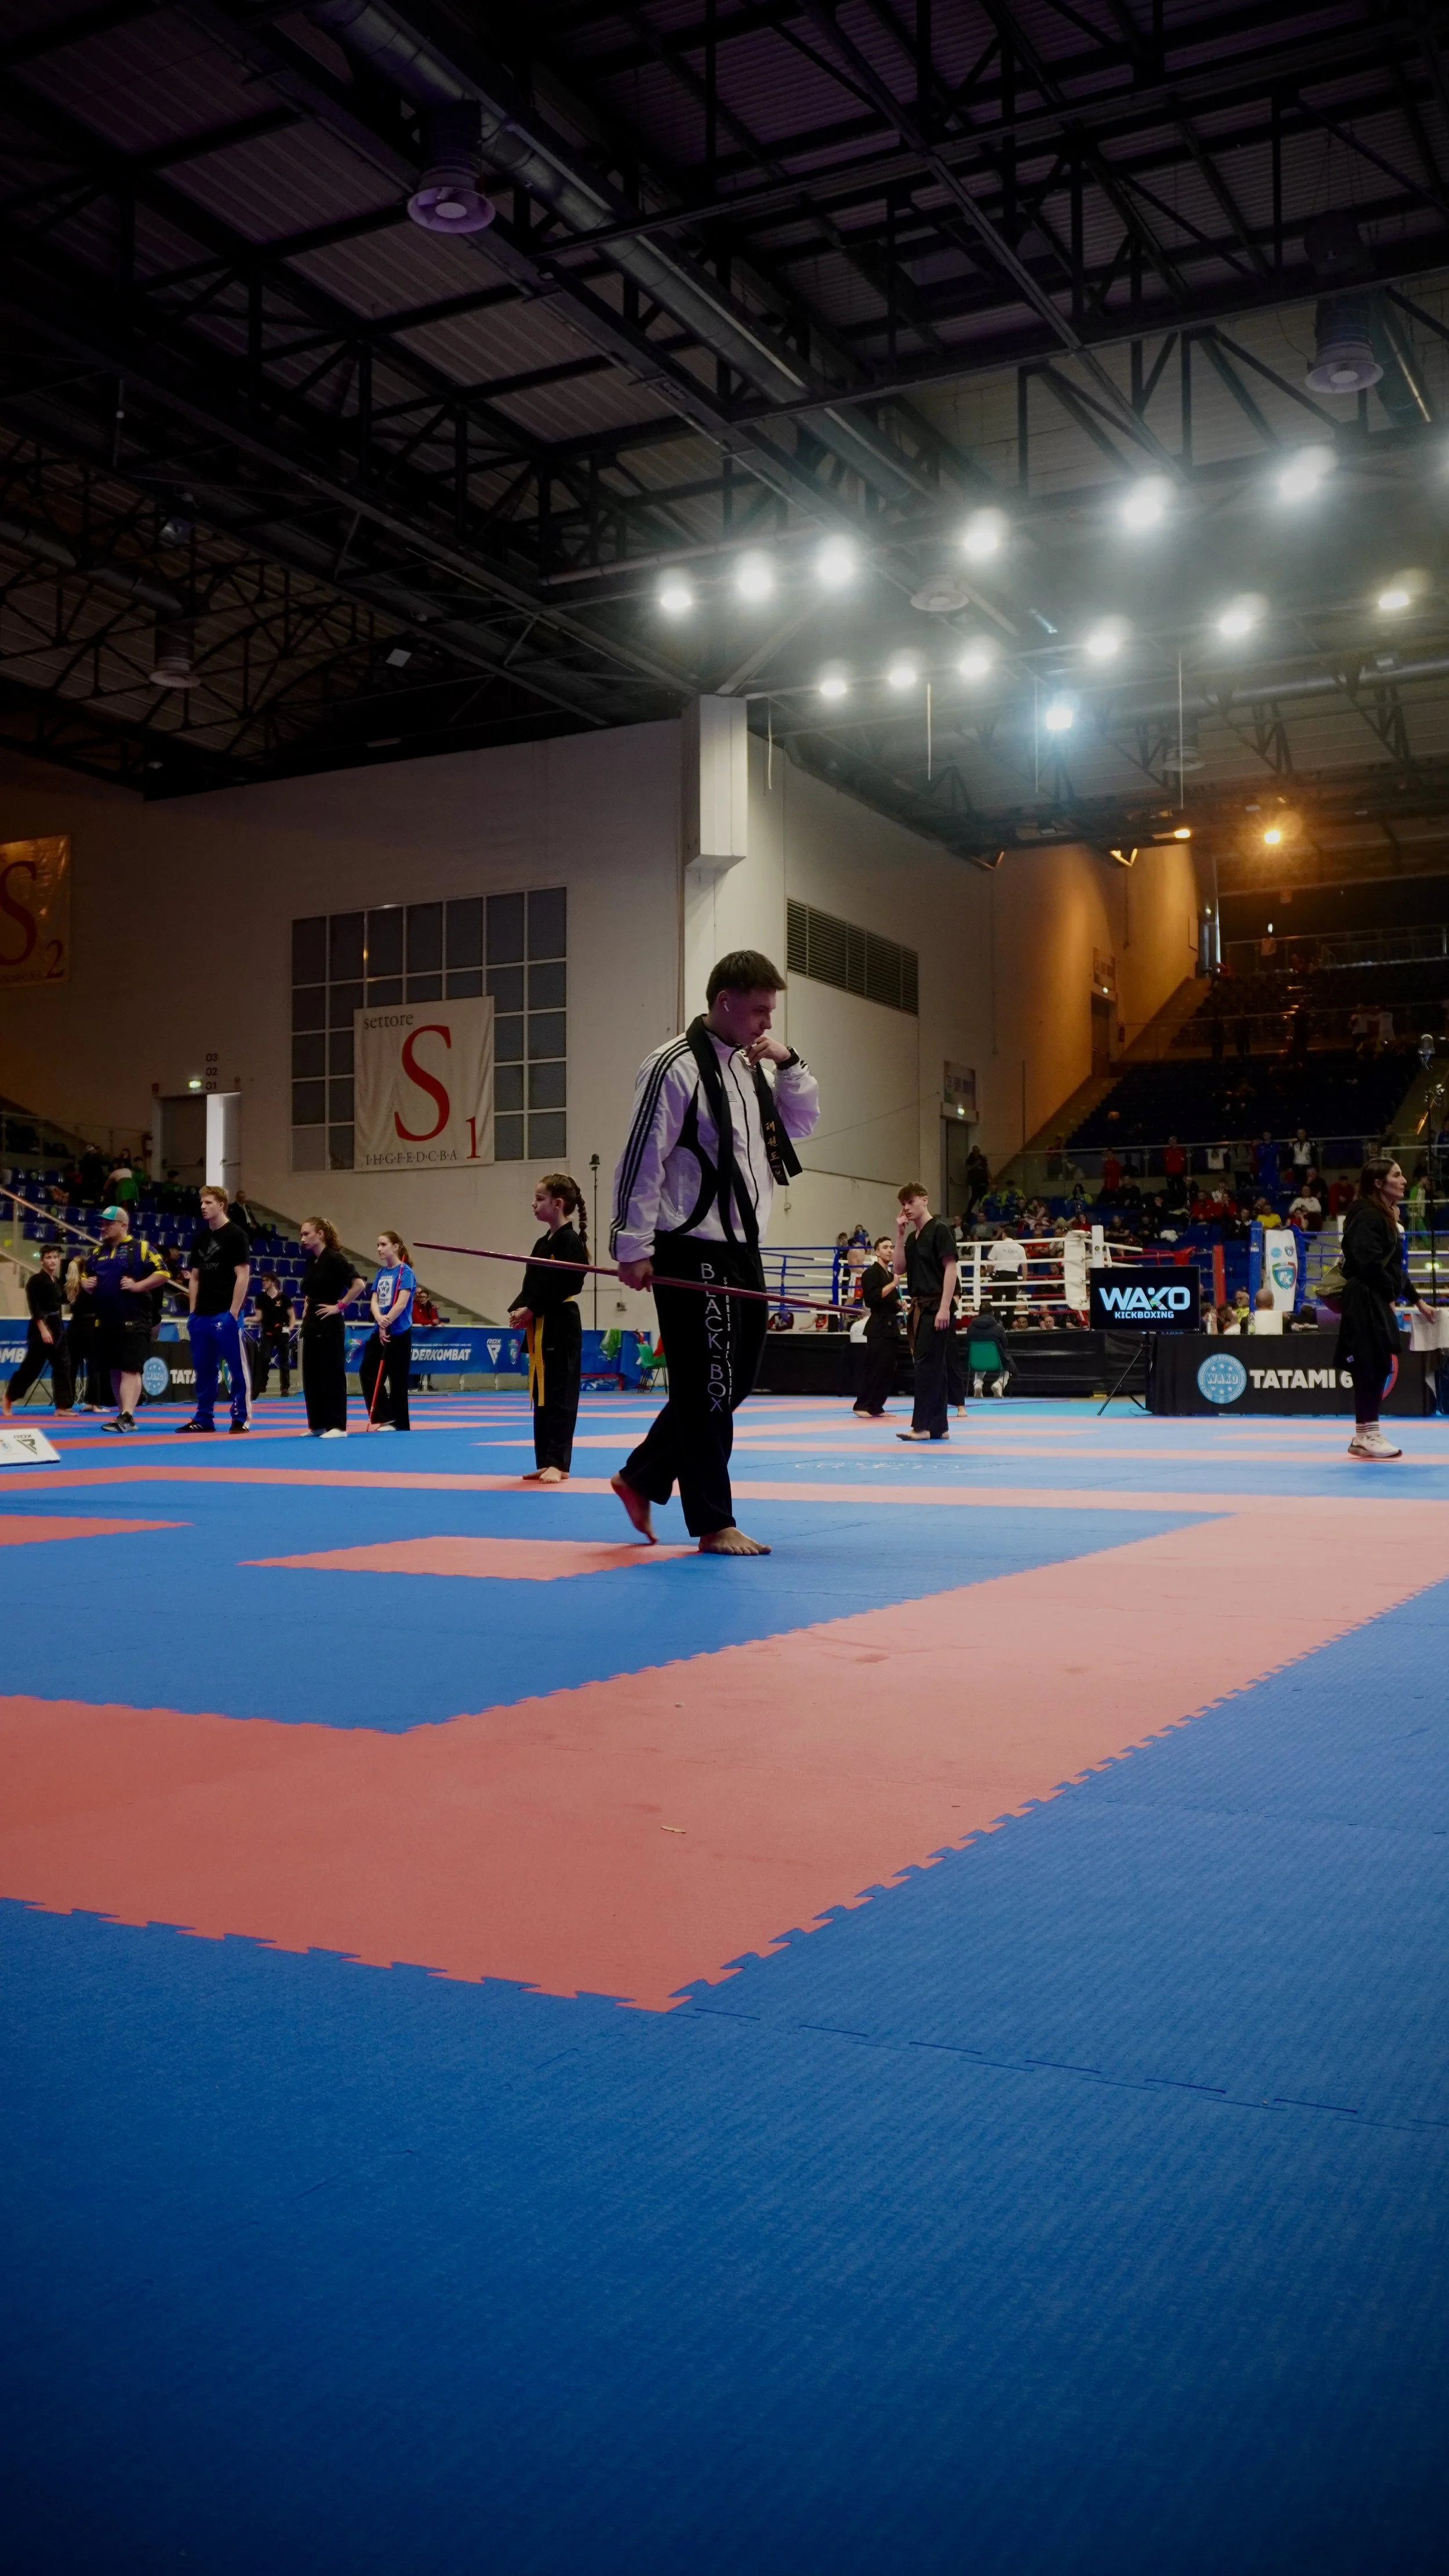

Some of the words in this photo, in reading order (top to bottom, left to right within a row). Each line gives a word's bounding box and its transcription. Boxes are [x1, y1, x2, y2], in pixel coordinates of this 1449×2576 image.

[45, 940, 63, 979] 2
[363, 1013, 414, 1029] settore
[394, 1024, 451, 1141] S
[466, 1116, 480, 1159] 1
[722, 1276, 731, 1332] SORTS
[1098, 1286, 1191, 1311] WAKO
[1115, 1311, 1174, 1319] KICKBOXING
[410, 1349, 471, 1361] DERKOMBAT
[170, 1369, 197, 1384] TATA
[1205, 1373, 1239, 1385] WAKO
[1250, 1369, 1336, 1389] TATAMI
[1340, 1371, 1354, 1389] 6
